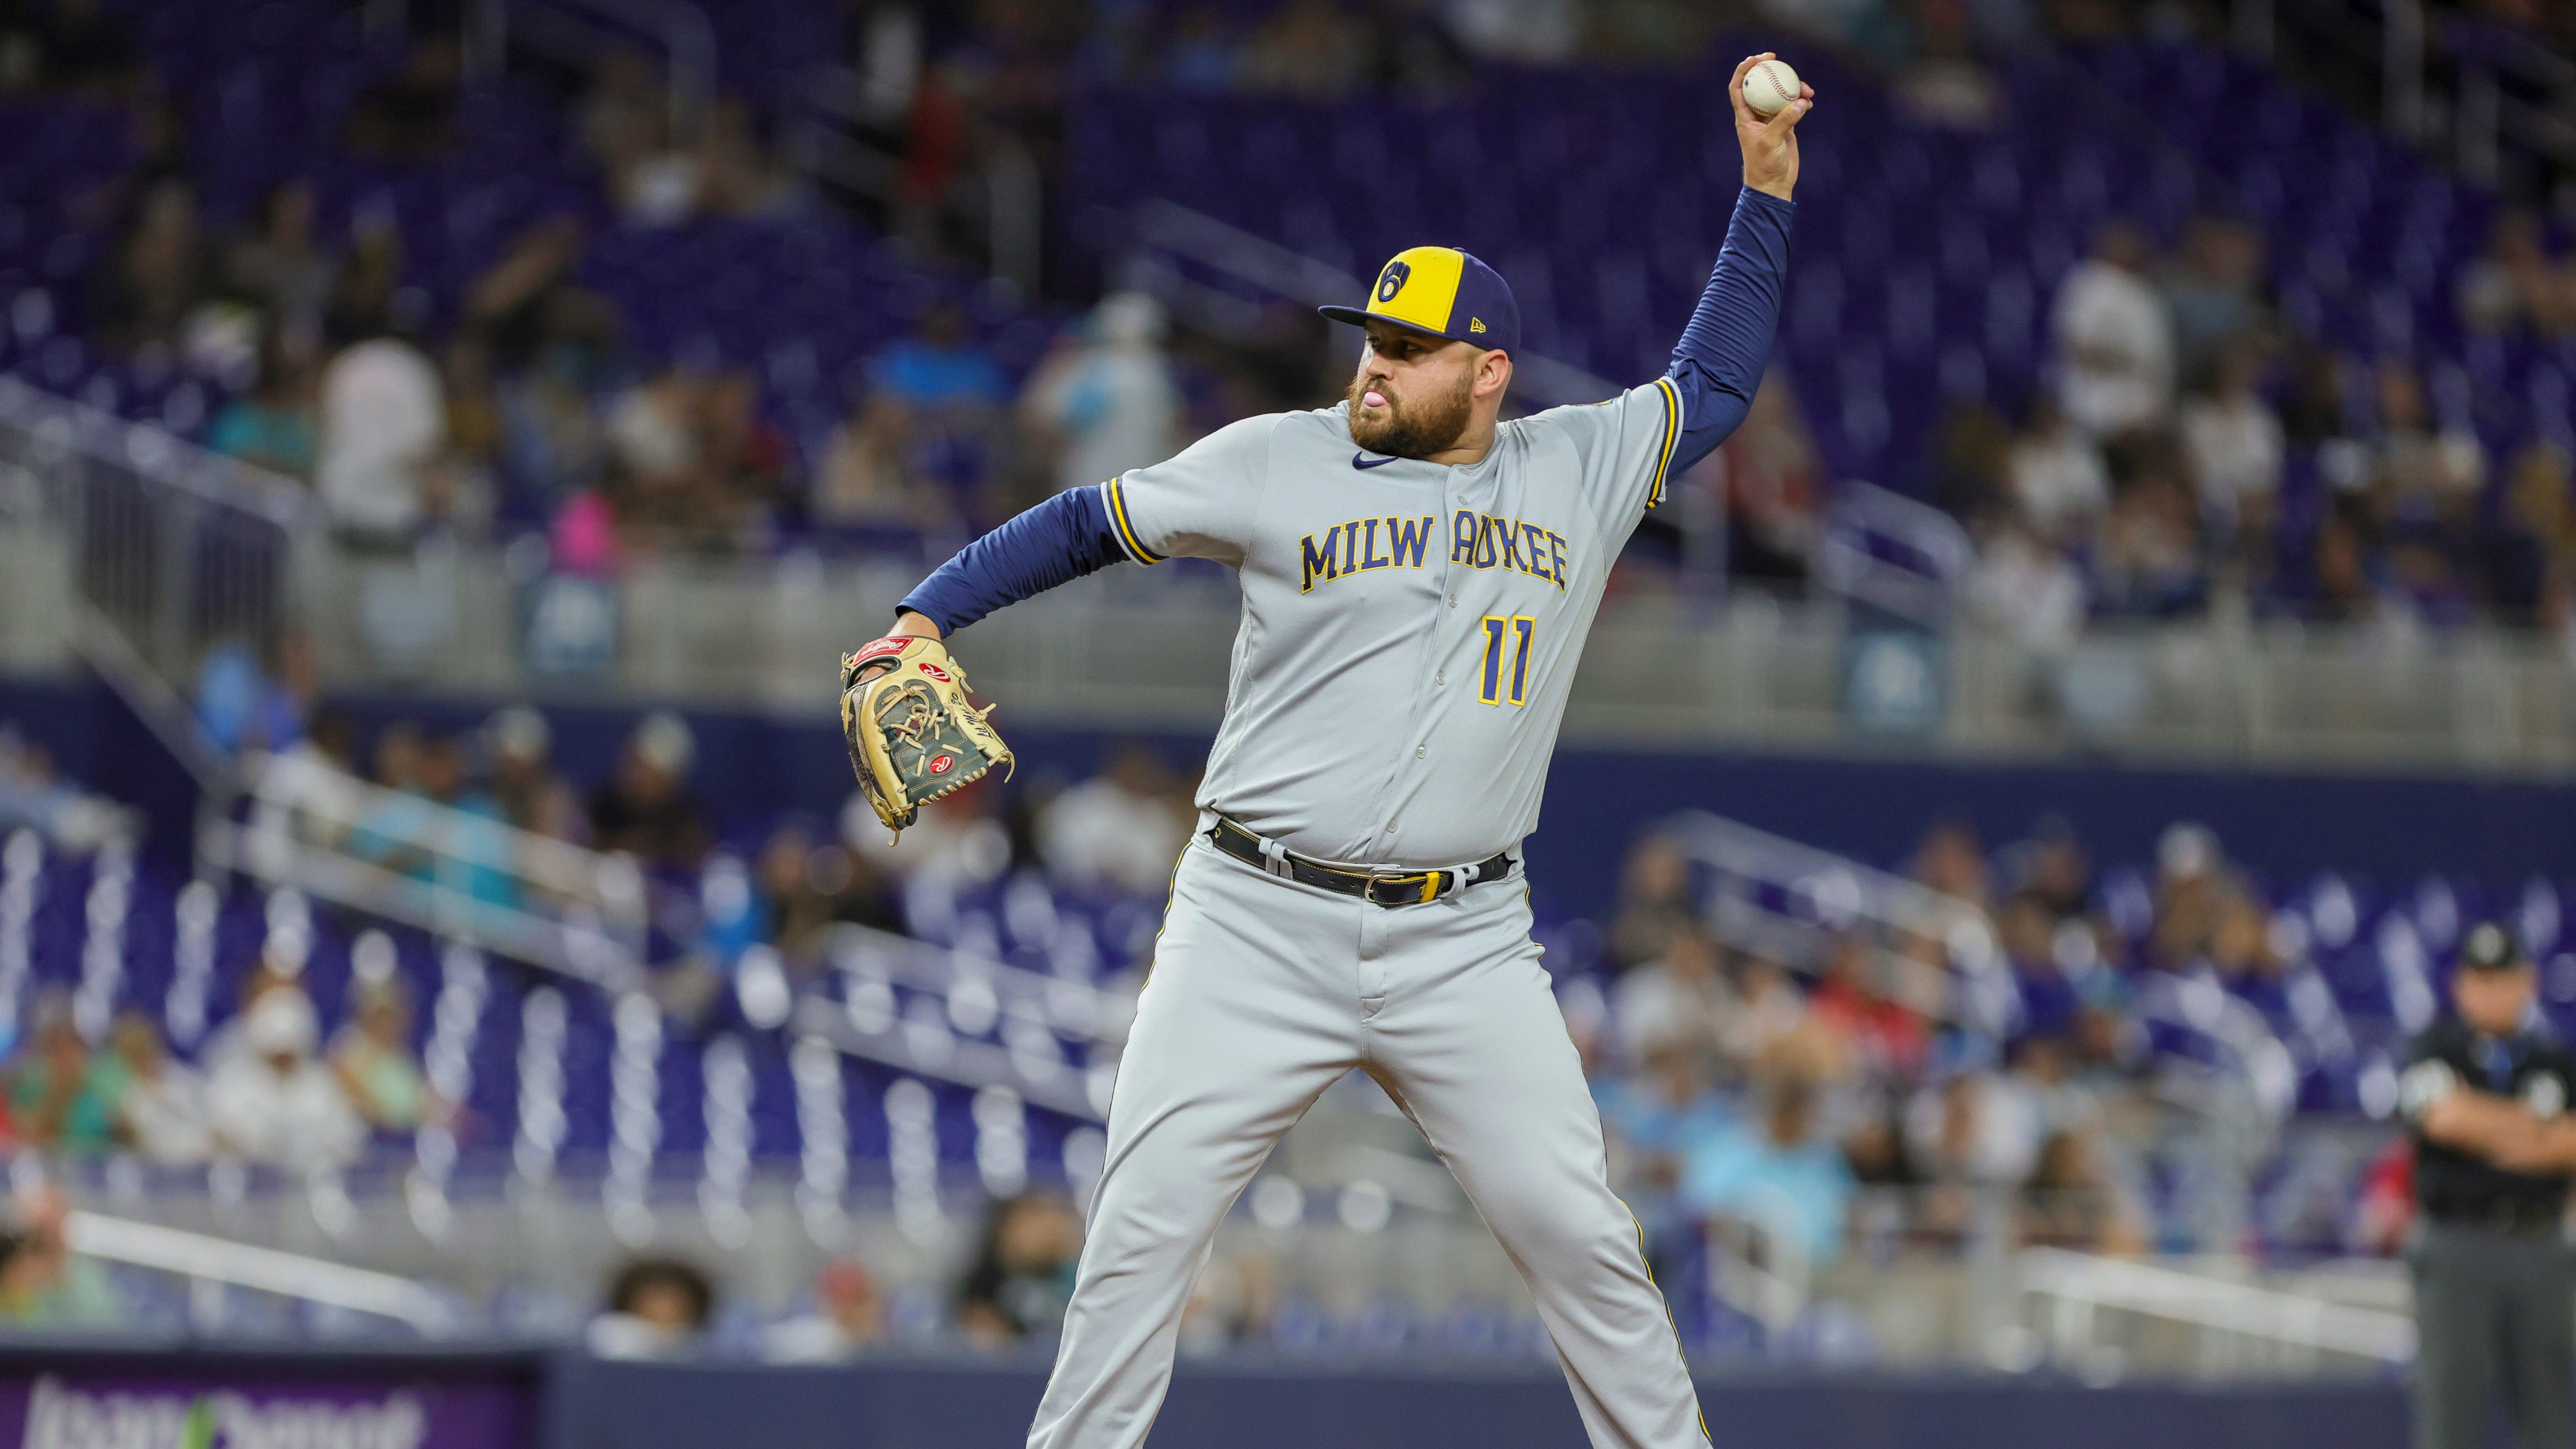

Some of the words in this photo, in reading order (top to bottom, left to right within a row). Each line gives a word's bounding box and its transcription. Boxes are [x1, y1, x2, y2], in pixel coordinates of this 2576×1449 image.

[1300, 509, 1568, 595] MILWAUKEE
[951, 693, 962, 705] 20
[1478, 615, 1537, 706] 11
